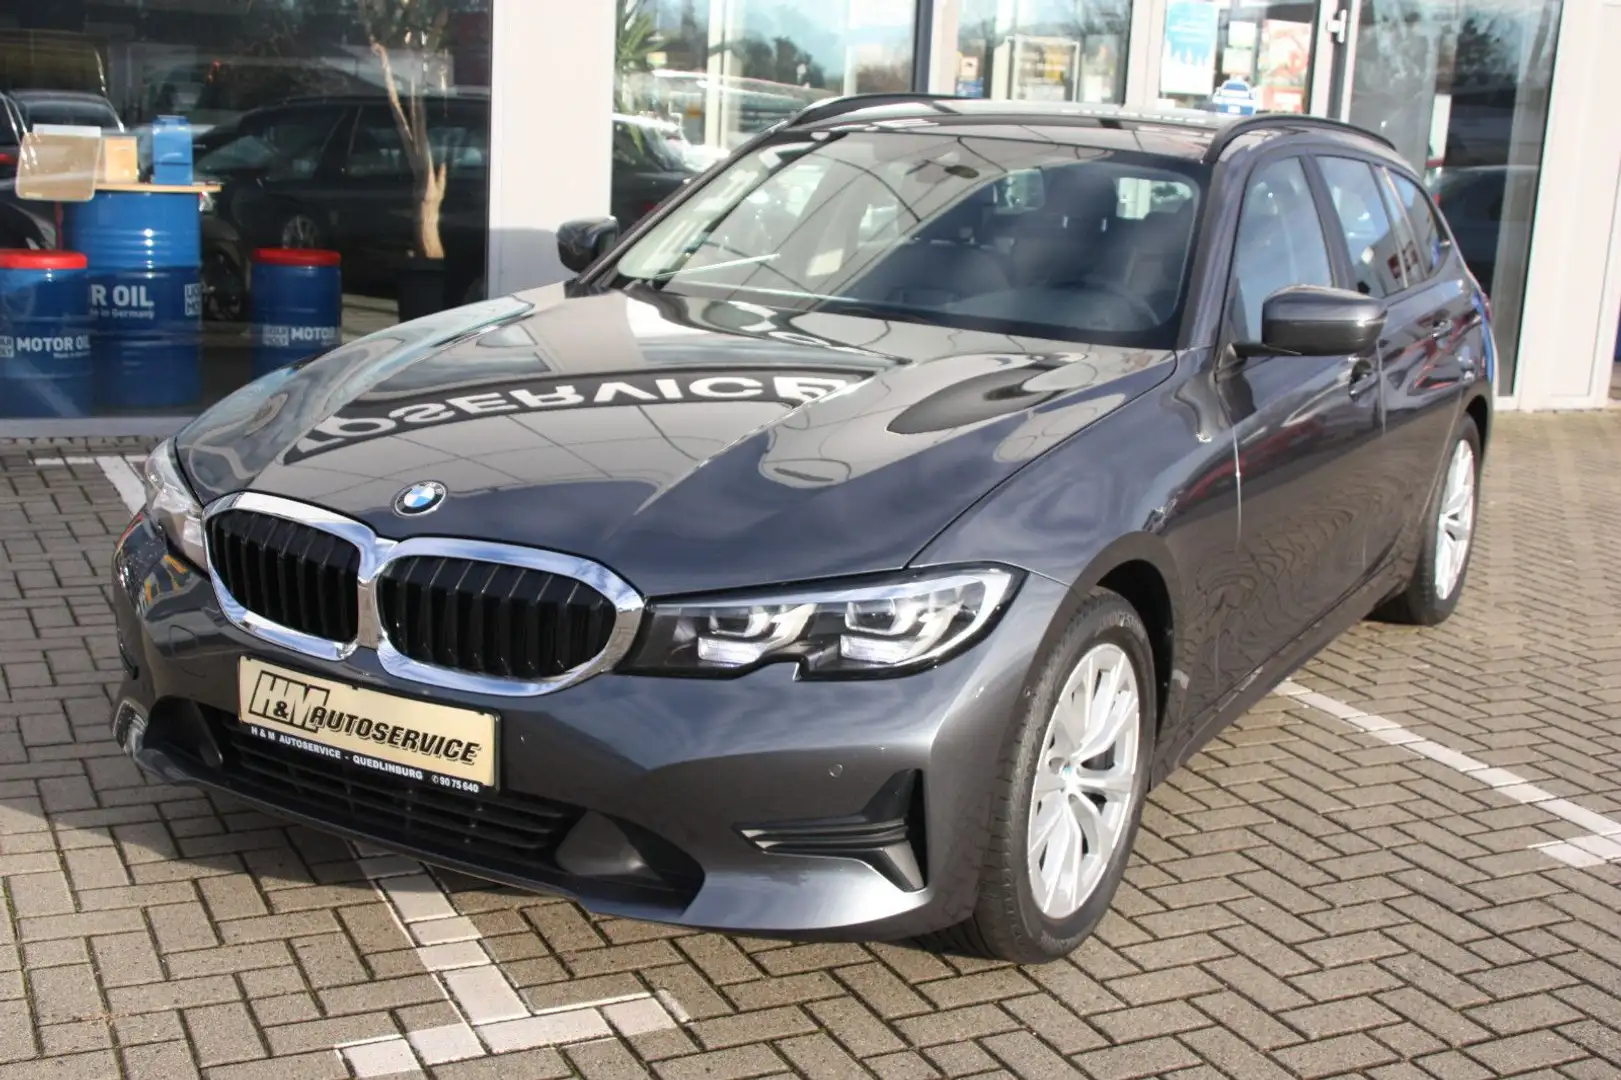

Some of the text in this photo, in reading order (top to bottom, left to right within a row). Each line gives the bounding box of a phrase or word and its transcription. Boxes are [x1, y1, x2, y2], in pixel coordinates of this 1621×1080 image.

[112, 284, 155, 307] OIL
[16, 335, 73, 352] MOTOR
[309, 705, 481, 765] AUTOSERVICE
[250, 726, 258, 735] H
[259, 729, 266, 738] &
[267, 731, 276, 741] M
[279, 736, 341, 759] AUTOSERVICE
[353, 755, 424, 780] QUEDLINBURG
[439, 777, 451, 787] 90
[452, 779, 461, 789] 75
